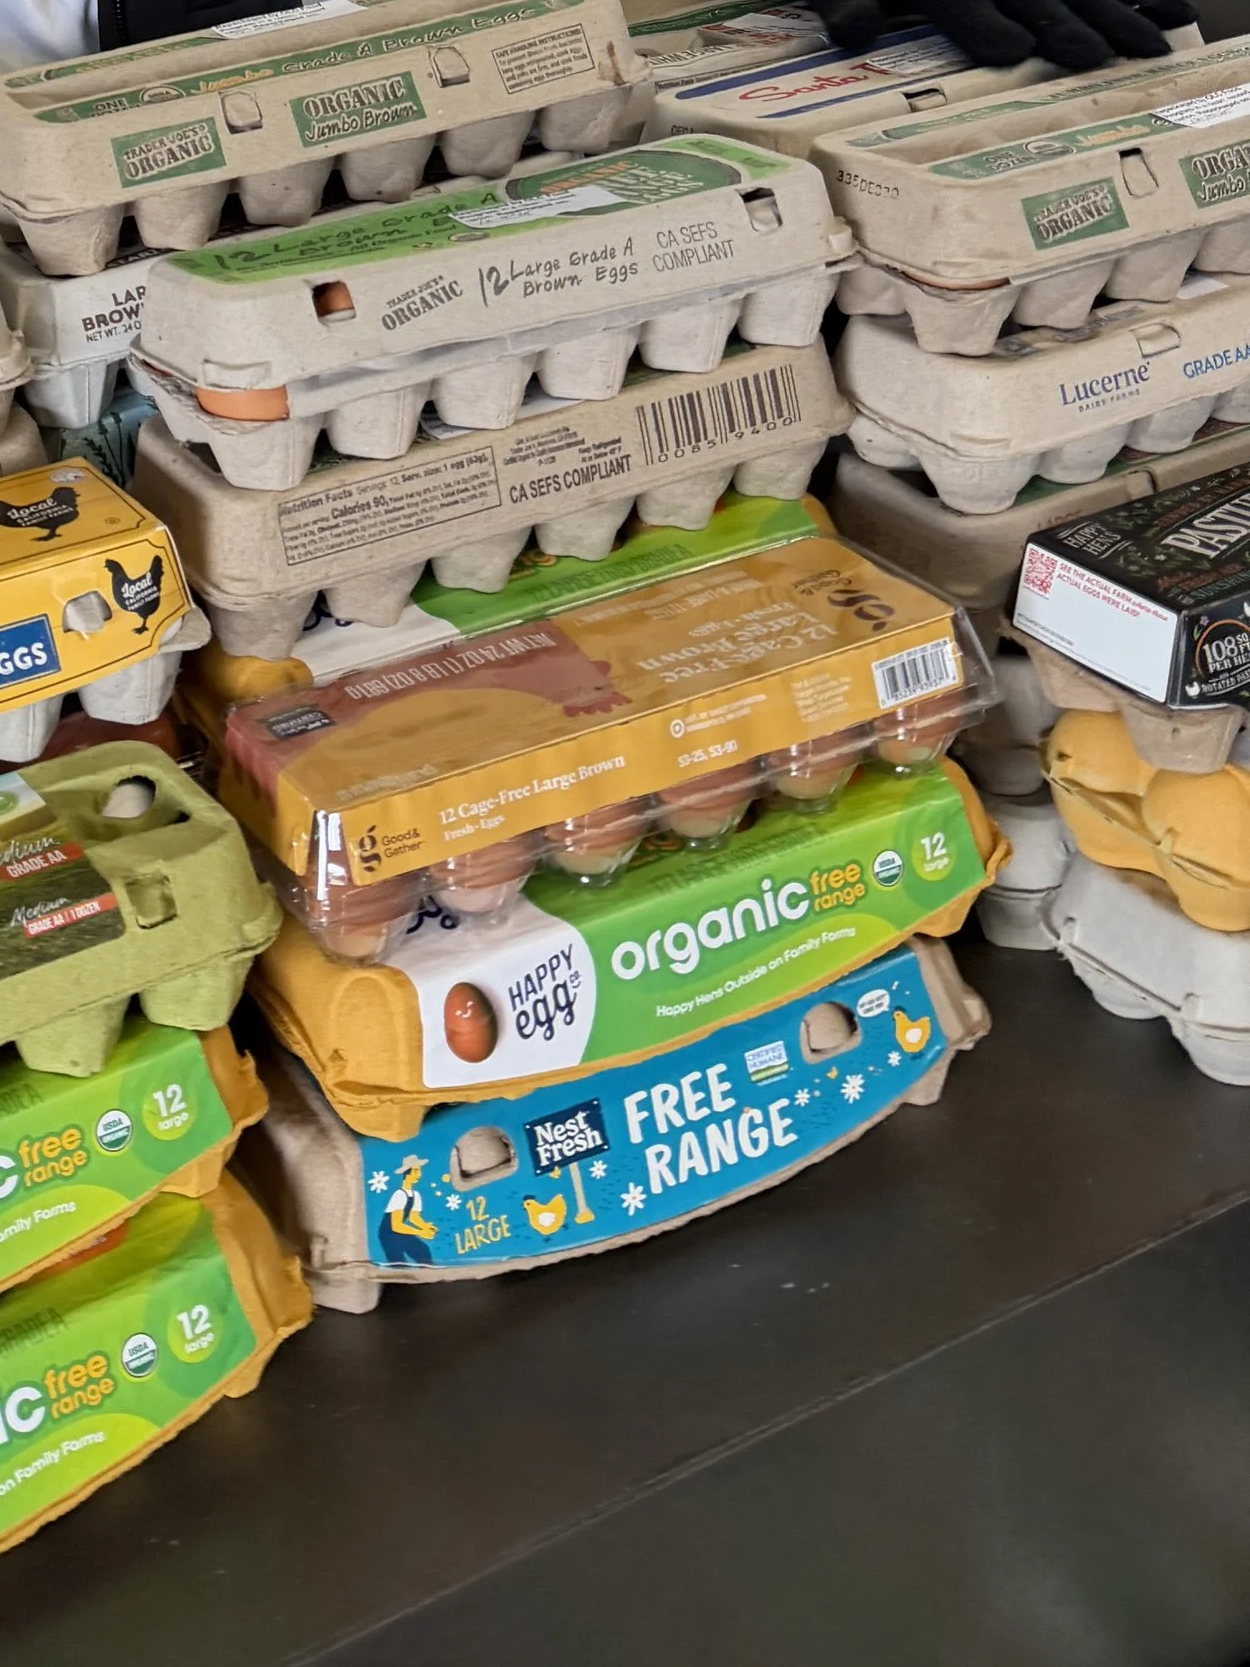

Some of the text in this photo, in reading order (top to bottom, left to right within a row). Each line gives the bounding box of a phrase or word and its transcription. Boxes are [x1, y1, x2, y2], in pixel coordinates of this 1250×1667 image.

[303, 77, 406, 119] ORGANIC
[739, 75, 870, 103] Santa
[306, 101, 419, 142] Jumbo Brown
[124, 139, 167, 161] TRADER
[125, 134, 214, 181] ORGANIC
[1201, 173, 1245, 201] Jumbo
[656, 221, 719, 249] CA SEFS
[1036, 195, 1112, 240] ORGANIC
[478, 236, 634, 308] 12 Large Grade A
[652, 239, 738, 273] COMPLIANT
[523, 263, 639, 299] Brown Eggs
[381, 280, 464, 332] ORGANIC
[386, 292, 410, 309] TRADER
[1182, 349, 1232, 381] GRADE
[1059, 359, 1149, 408] Lucerne
[1078, 389, 1141, 414] DAIRY FARMS
[509, 454, 631, 504] CA SEFS COMPLIANT
[331, 501, 372, 519] Calories
[121, 572, 153, 598] Local
[1059, 562, 1085, 578] SEE THE
[1201, 635, 1238, 662] 108
[1208, 660, 1232, 673] PER
[438, 806, 456, 825] 12
[459, 782, 531, 820] Cage-Free
[532, 768, 578, 795] Large
[578, 754, 626, 781] Brown
[920, 832, 948, 861] 12
[5, 851, 67, 880] GRADE AA
[810, 861, 863, 896] free
[812, 881, 867, 913] range
[611, 876, 810, 981] organic
[507, 943, 576, 1011] HAPPY
[656, 925, 857, 1019] Happy Hens Outside on Family Farms
[514, 982, 580, 1042] egg
[152, 1083, 188, 1118] 12
[623, 1063, 736, 1145] FREE
[158, 1110, 190, 1132] large
[534, 1110, 589, 1147] Nest
[18, 1126, 83, 1168] free
[536, 1128, 605, 1168] Fresh
[642, 1098, 798, 1195] RANGE
[23, 1149, 88, 1189] range
[34, 1199, 77, 1226] Farms
[465, 1196, 488, 1223] 12
[454, 1214, 512, 1255] LARGE
[176, 1305, 213, 1339] 12
[182, 1329, 216, 1355] large
[43, 1350, 110, 1400] free
[47, 1376, 116, 1420] range
[14, 1450, 61, 1488] Family
[61, 1429, 106, 1459] Farms
